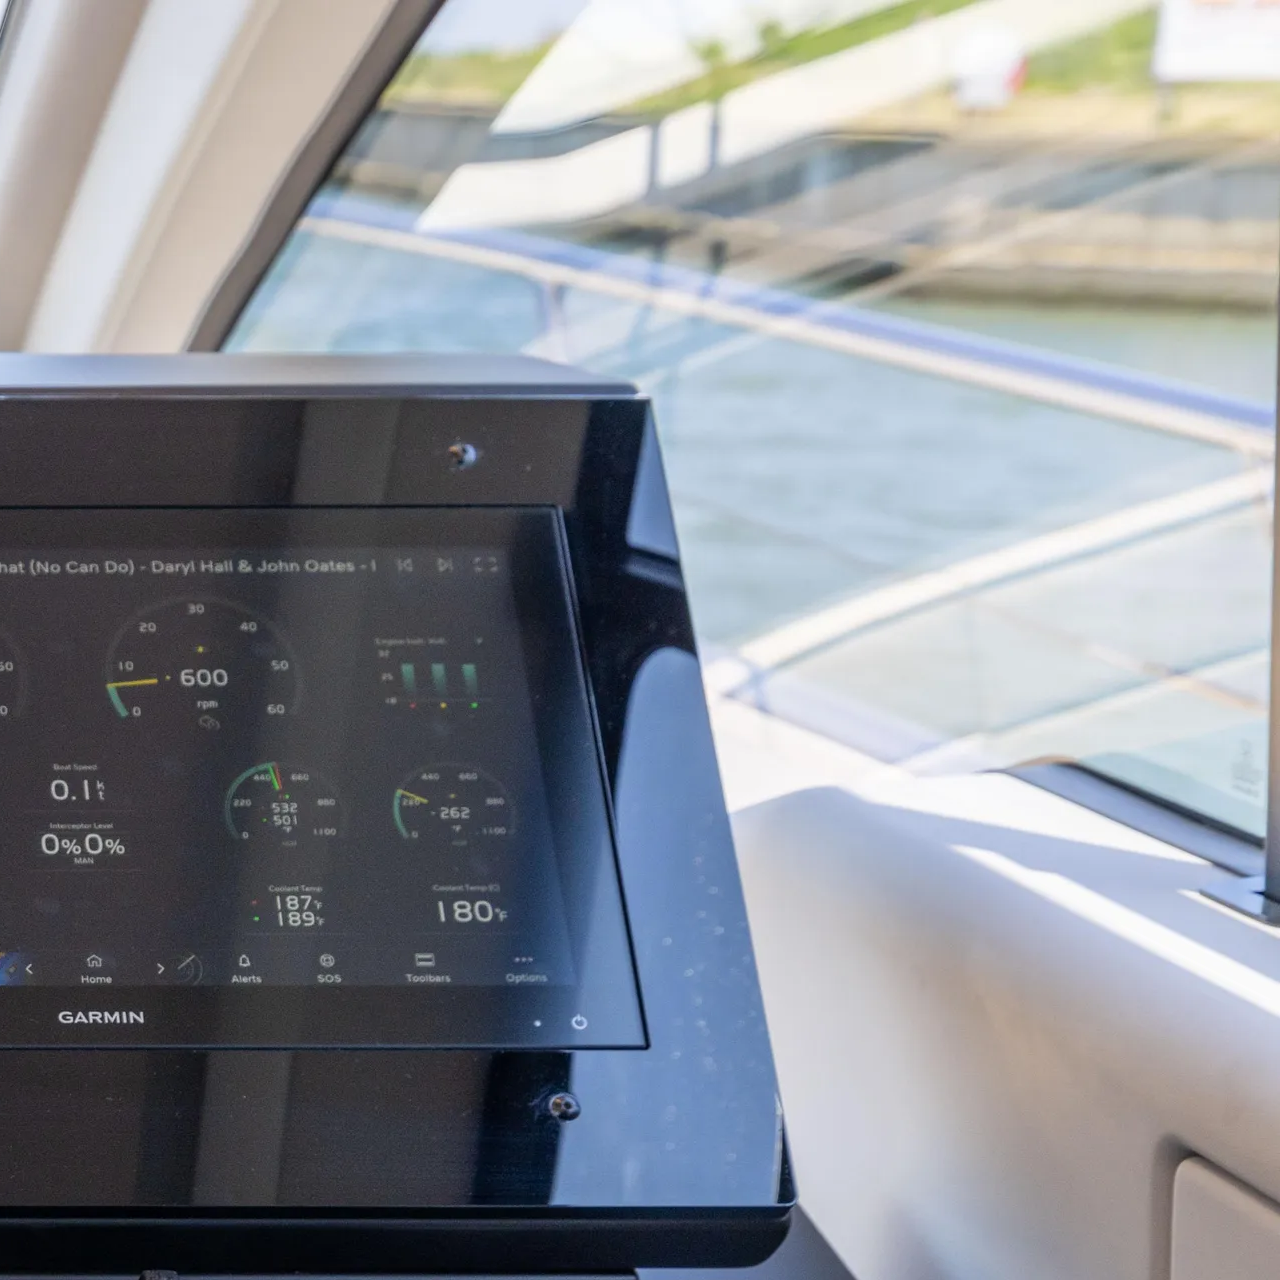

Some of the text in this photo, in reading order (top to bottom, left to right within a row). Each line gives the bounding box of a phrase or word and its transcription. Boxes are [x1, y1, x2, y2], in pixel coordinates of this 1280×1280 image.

[30, 558, 61, 576] (No
[66, 561, 99, 574] Can
[105, 558, 135, 576] Do)
[152, 559, 195, 576] Daryl
[201, 559, 233, 573] Hall
[258, 559, 299, 573] John
[304, 559, 355, 573] Oates
[180, 669, 228, 686] 600
[197, 700, 218, 709] rpm
[50, 780, 90, 800] 0.1
[440, 807, 470, 819] 262
[273, 816, 298, 825] 501
[81, 975, 112, 984] Home
[231, 974, 262, 983] Alerts
[317, 974, 341, 983] SOS
[405, 974, 451, 983] Toolbars
[506, 973, 548, 984] Options
[58, 1011, 144, 1024] GARMIN
